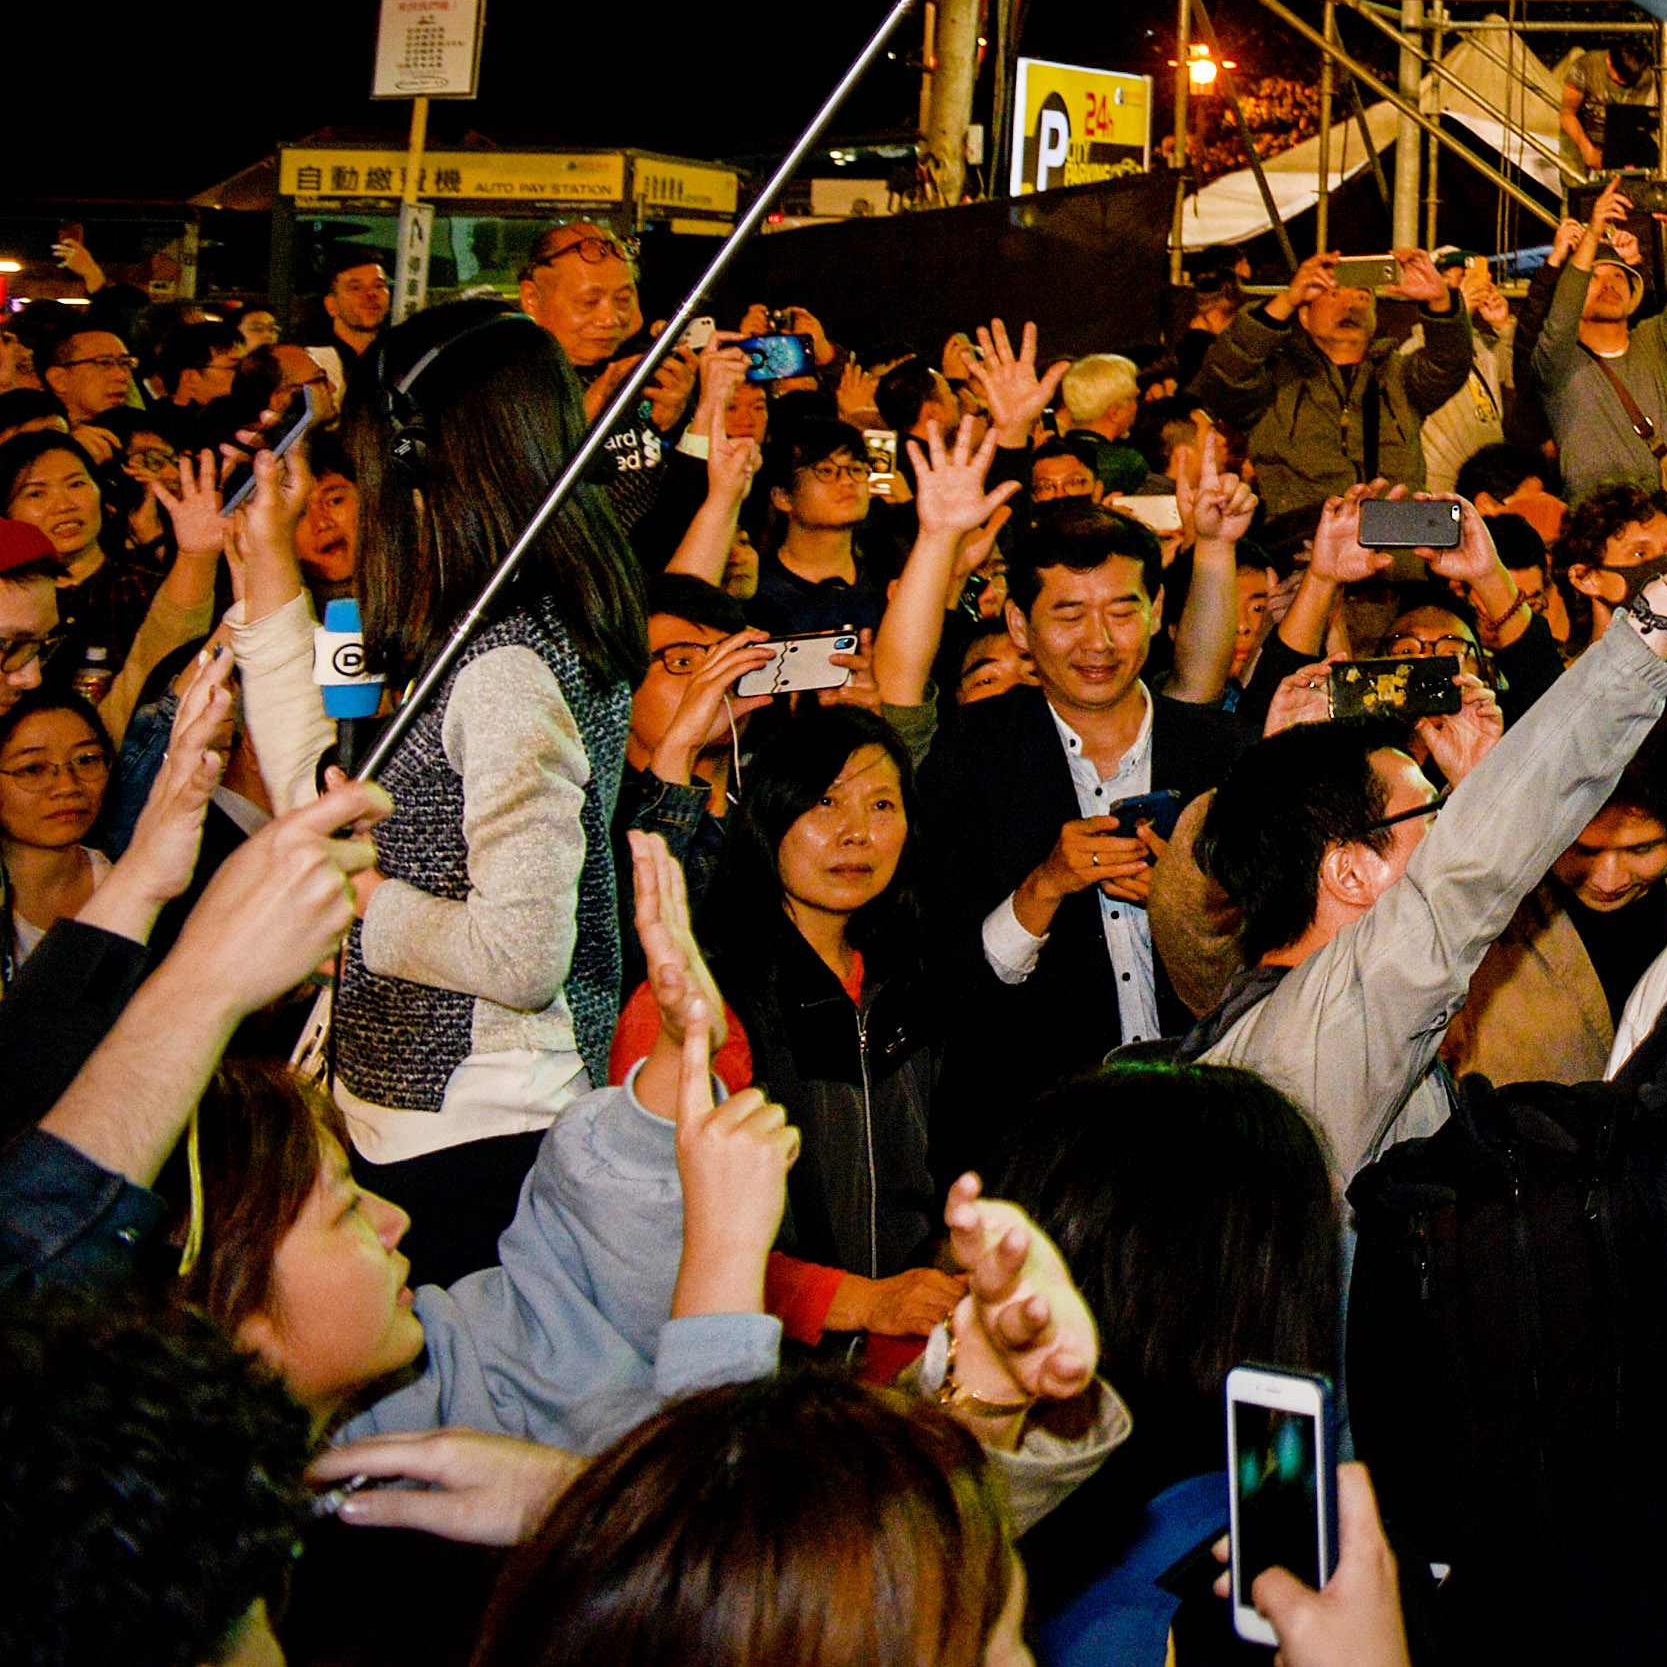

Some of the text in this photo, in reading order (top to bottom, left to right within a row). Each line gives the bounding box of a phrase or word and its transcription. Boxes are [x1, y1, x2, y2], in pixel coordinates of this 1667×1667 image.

[1037, 109, 1069, 192] P
[475, 181, 613, 196] AUTO PAY STATION
